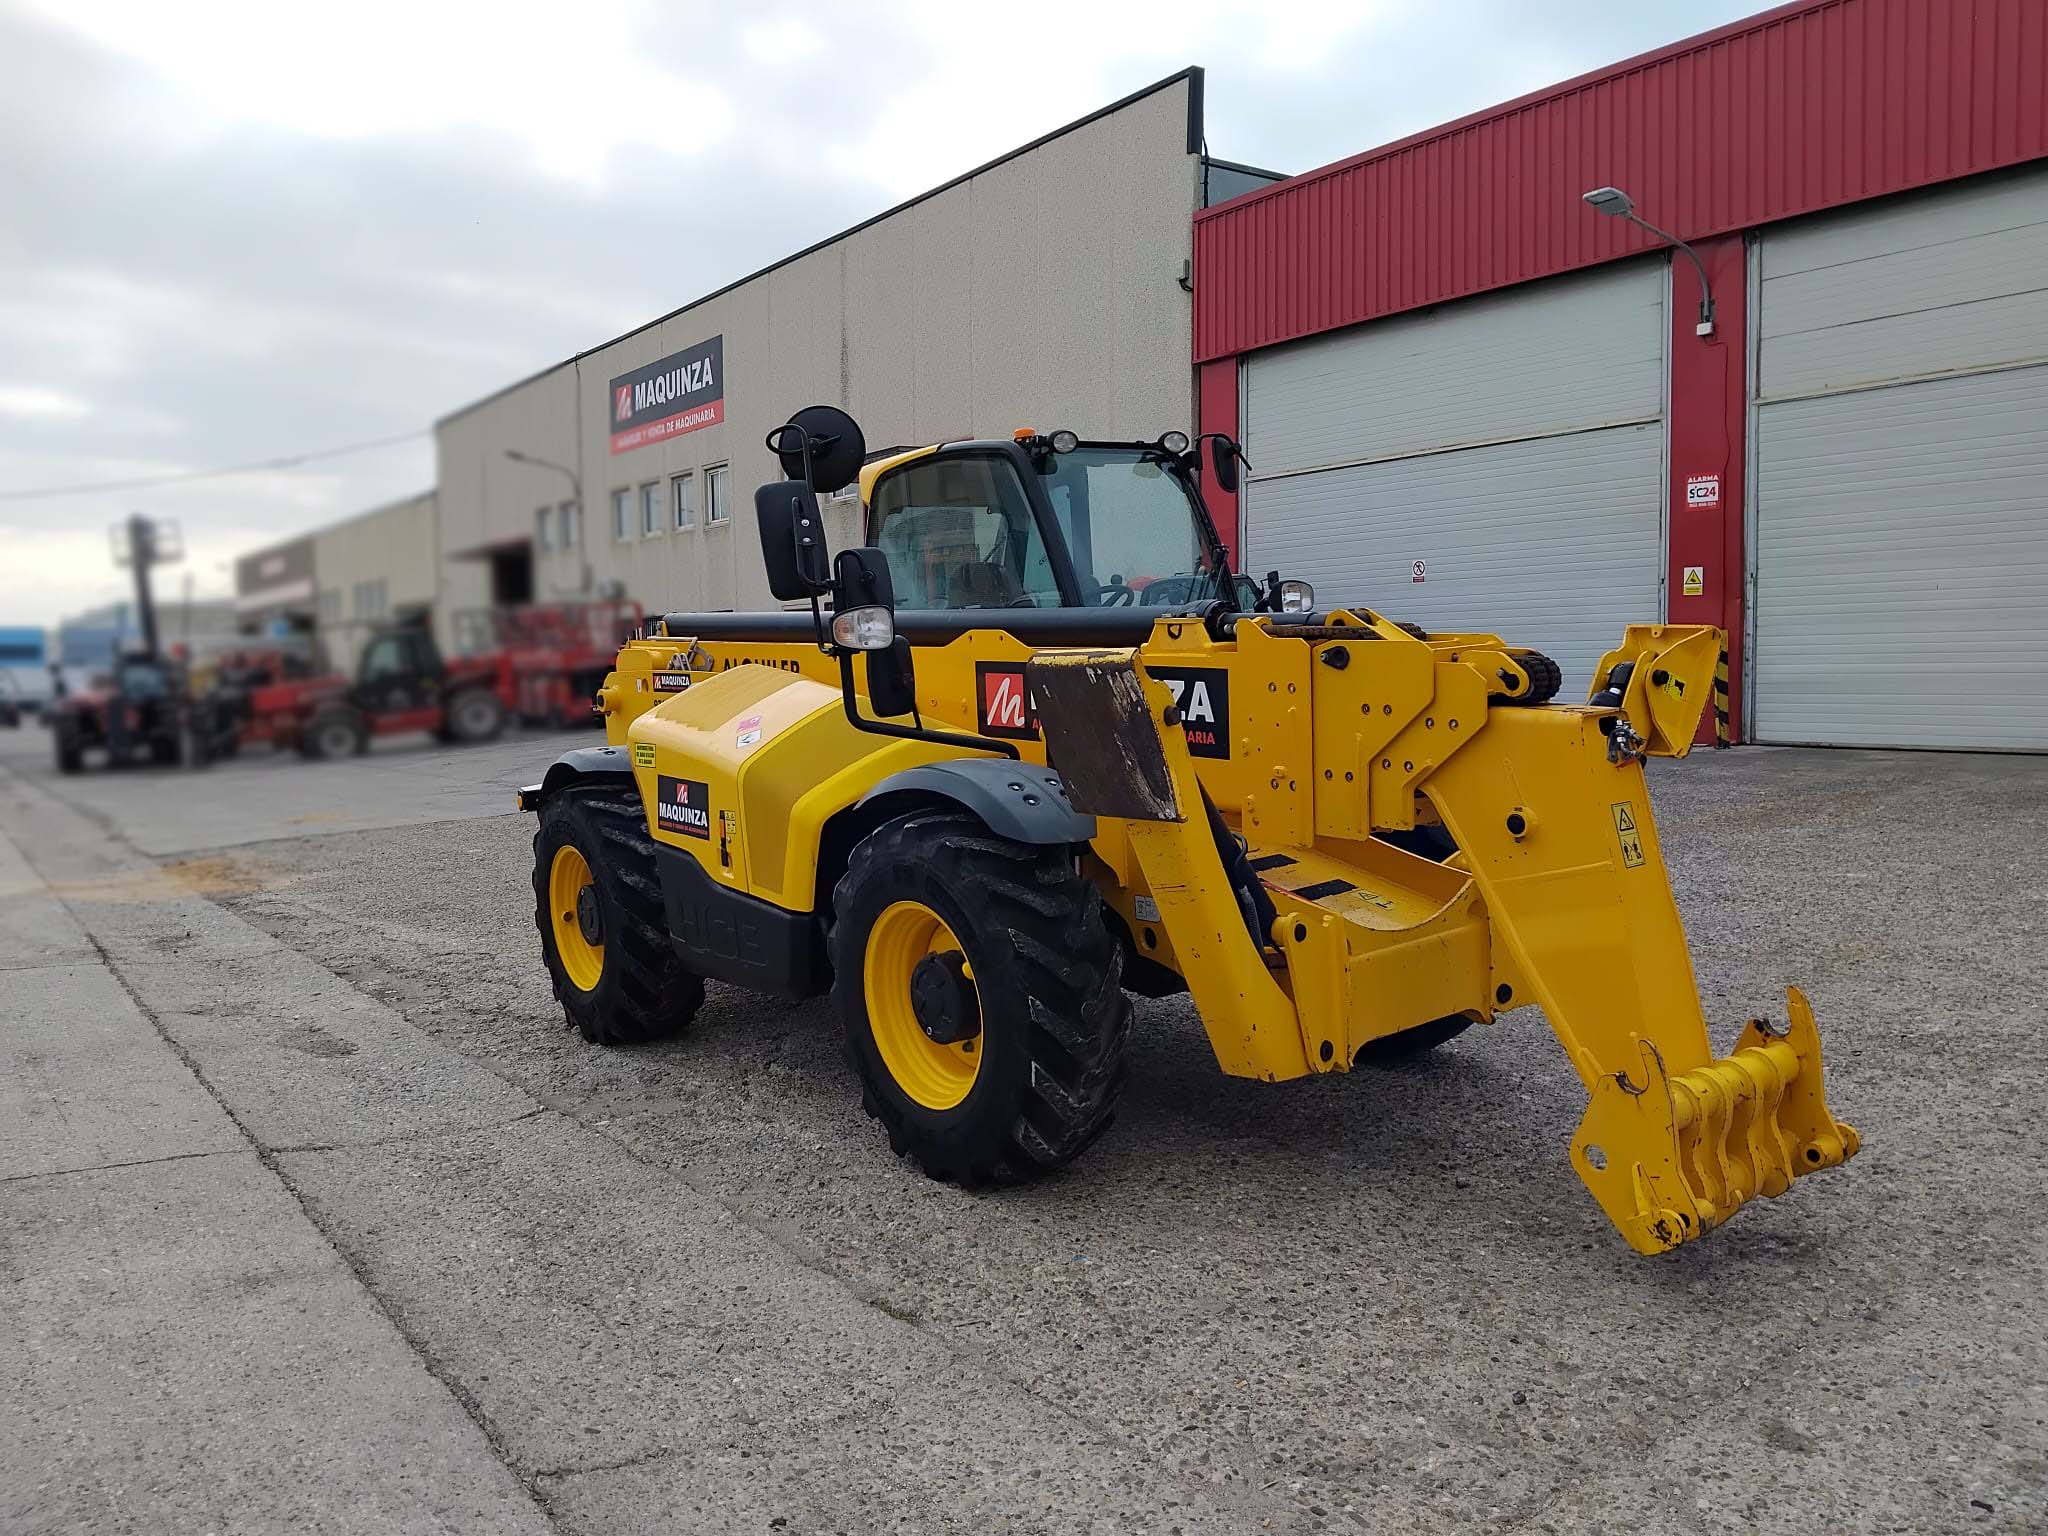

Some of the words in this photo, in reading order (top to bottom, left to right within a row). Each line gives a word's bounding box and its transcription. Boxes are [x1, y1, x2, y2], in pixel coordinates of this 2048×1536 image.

[635, 357, 714, 411] MAQUINZA
[675, 407, 715, 430] MAQUINARIA
[1688, 474, 1719, 483] ALARMA
[661, 675, 690, 686] MAQUINZA
[659, 801, 708, 827] MAQUINZA
